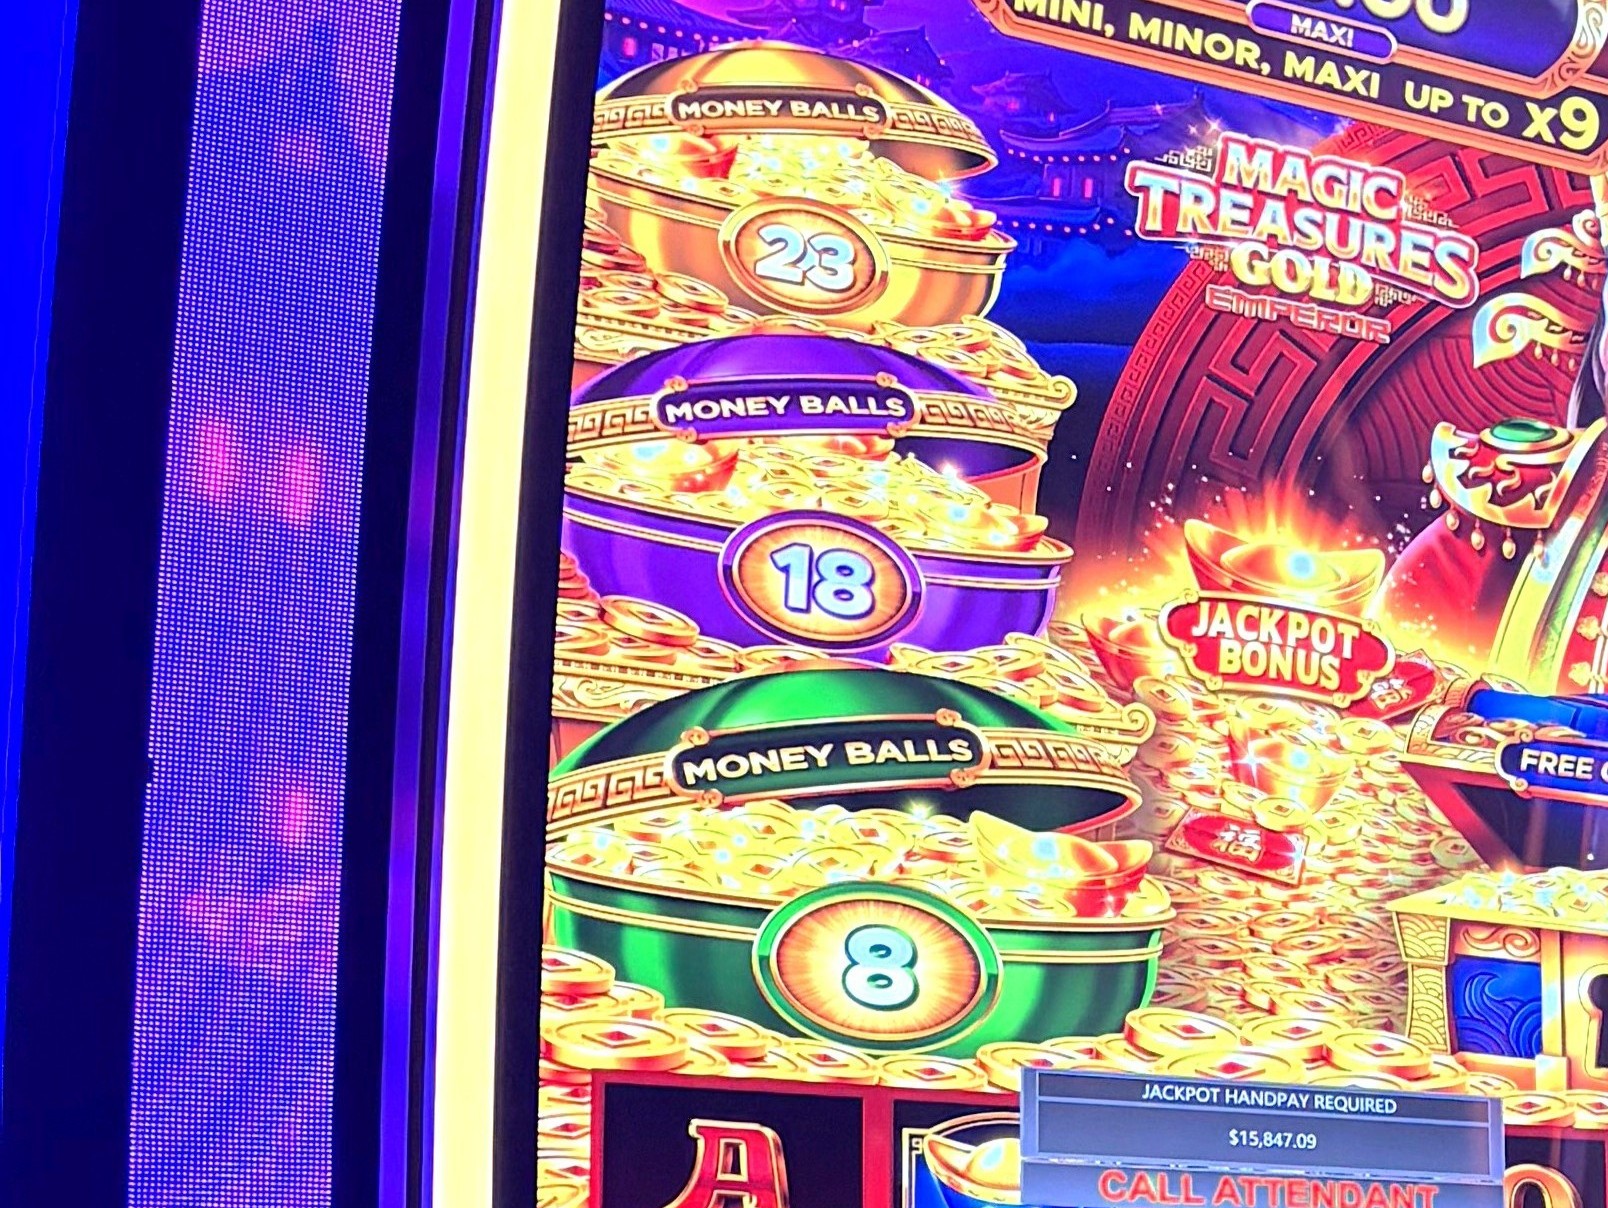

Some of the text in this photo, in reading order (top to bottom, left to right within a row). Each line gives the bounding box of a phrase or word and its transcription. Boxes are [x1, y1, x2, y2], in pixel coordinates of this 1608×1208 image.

[1291, 15, 1353, 47] MAXI
[1129, 12, 1271, 75] MINOR,
[1284, 51, 1380, 98] MAXI
[1404, 81, 1453, 113] UP
[1462, 96, 1509, 128] TO
[678, 99, 880, 123] MONEY BALLS
[1219, 138, 1403, 223] MAGIC
[755, 225, 858, 291] 23
[1132, 168, 1474, 302] TREASURES
[1229, 241, 1375, 306] GOLD
[1205, 284, 1392, 344] EMPEROR
[665, 393, 906, 424] MONEY BALLS
[770, 541, 876, 618] 18
[1192, 601, 1358, 659] JACKPOT
[1217, 638, 1341, 691] BONUS
[682, 735, 973, 784] MONEY BALLS
[1519, 747, 1594, 781] FREE
[842, 924, 918, 1010] 8
[1142, 1084, 1397, 1115] JACKPOT HANDPAY REQUIRED
[1228, 1127, 1317, 1151] $15,847.09
[1098, 1168, 1205, 1206] CALL
